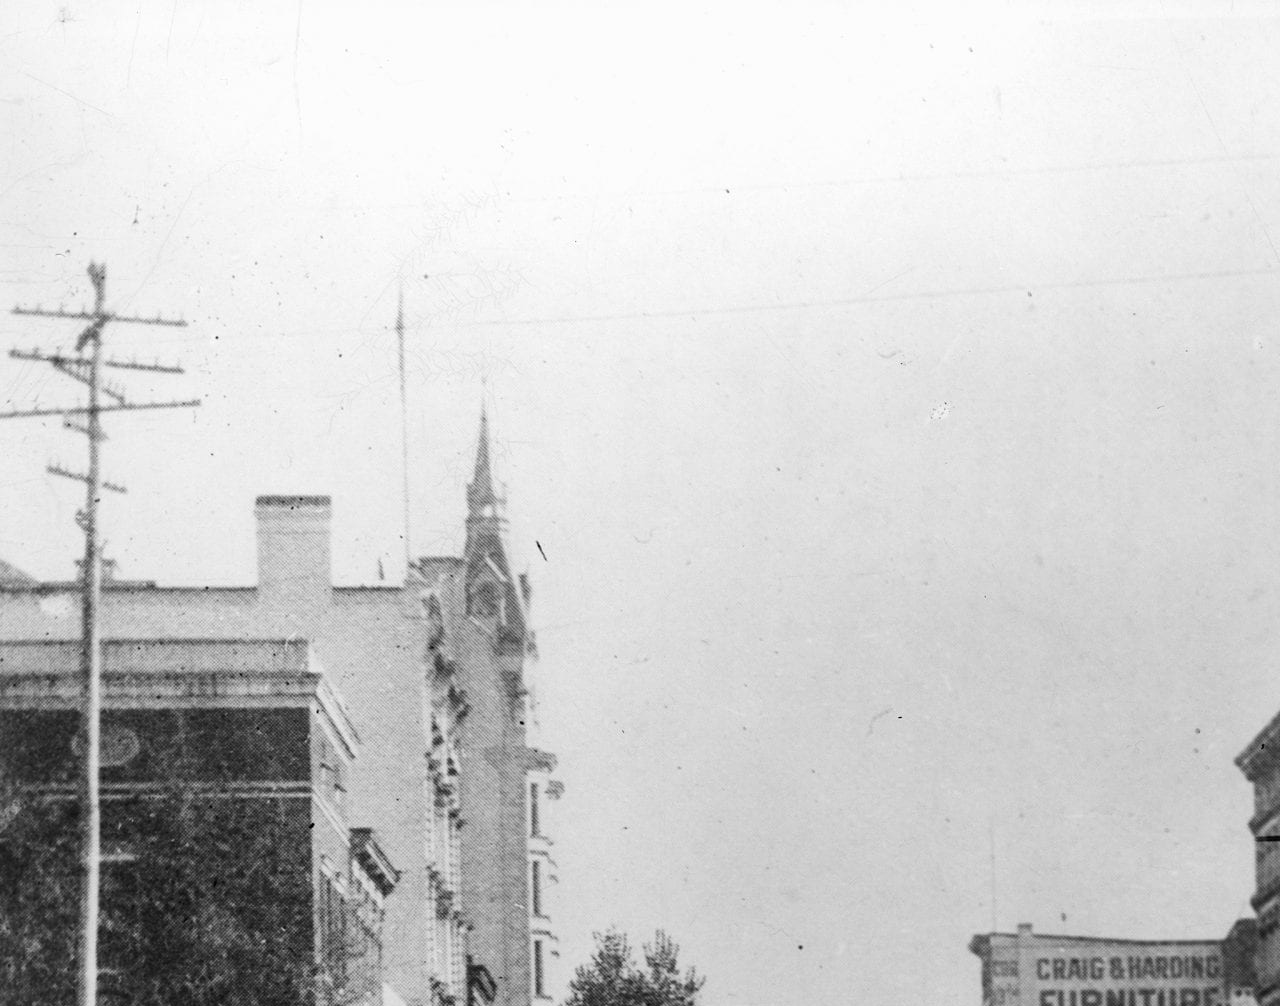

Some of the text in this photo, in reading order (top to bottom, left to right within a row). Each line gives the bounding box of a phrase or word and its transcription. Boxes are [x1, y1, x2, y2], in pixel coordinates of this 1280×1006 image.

[1036, 957, 1105, 980] CRAIG
[1109, 957, 1124, 980] &
[1127, 955, 1221, 979] HARDING
